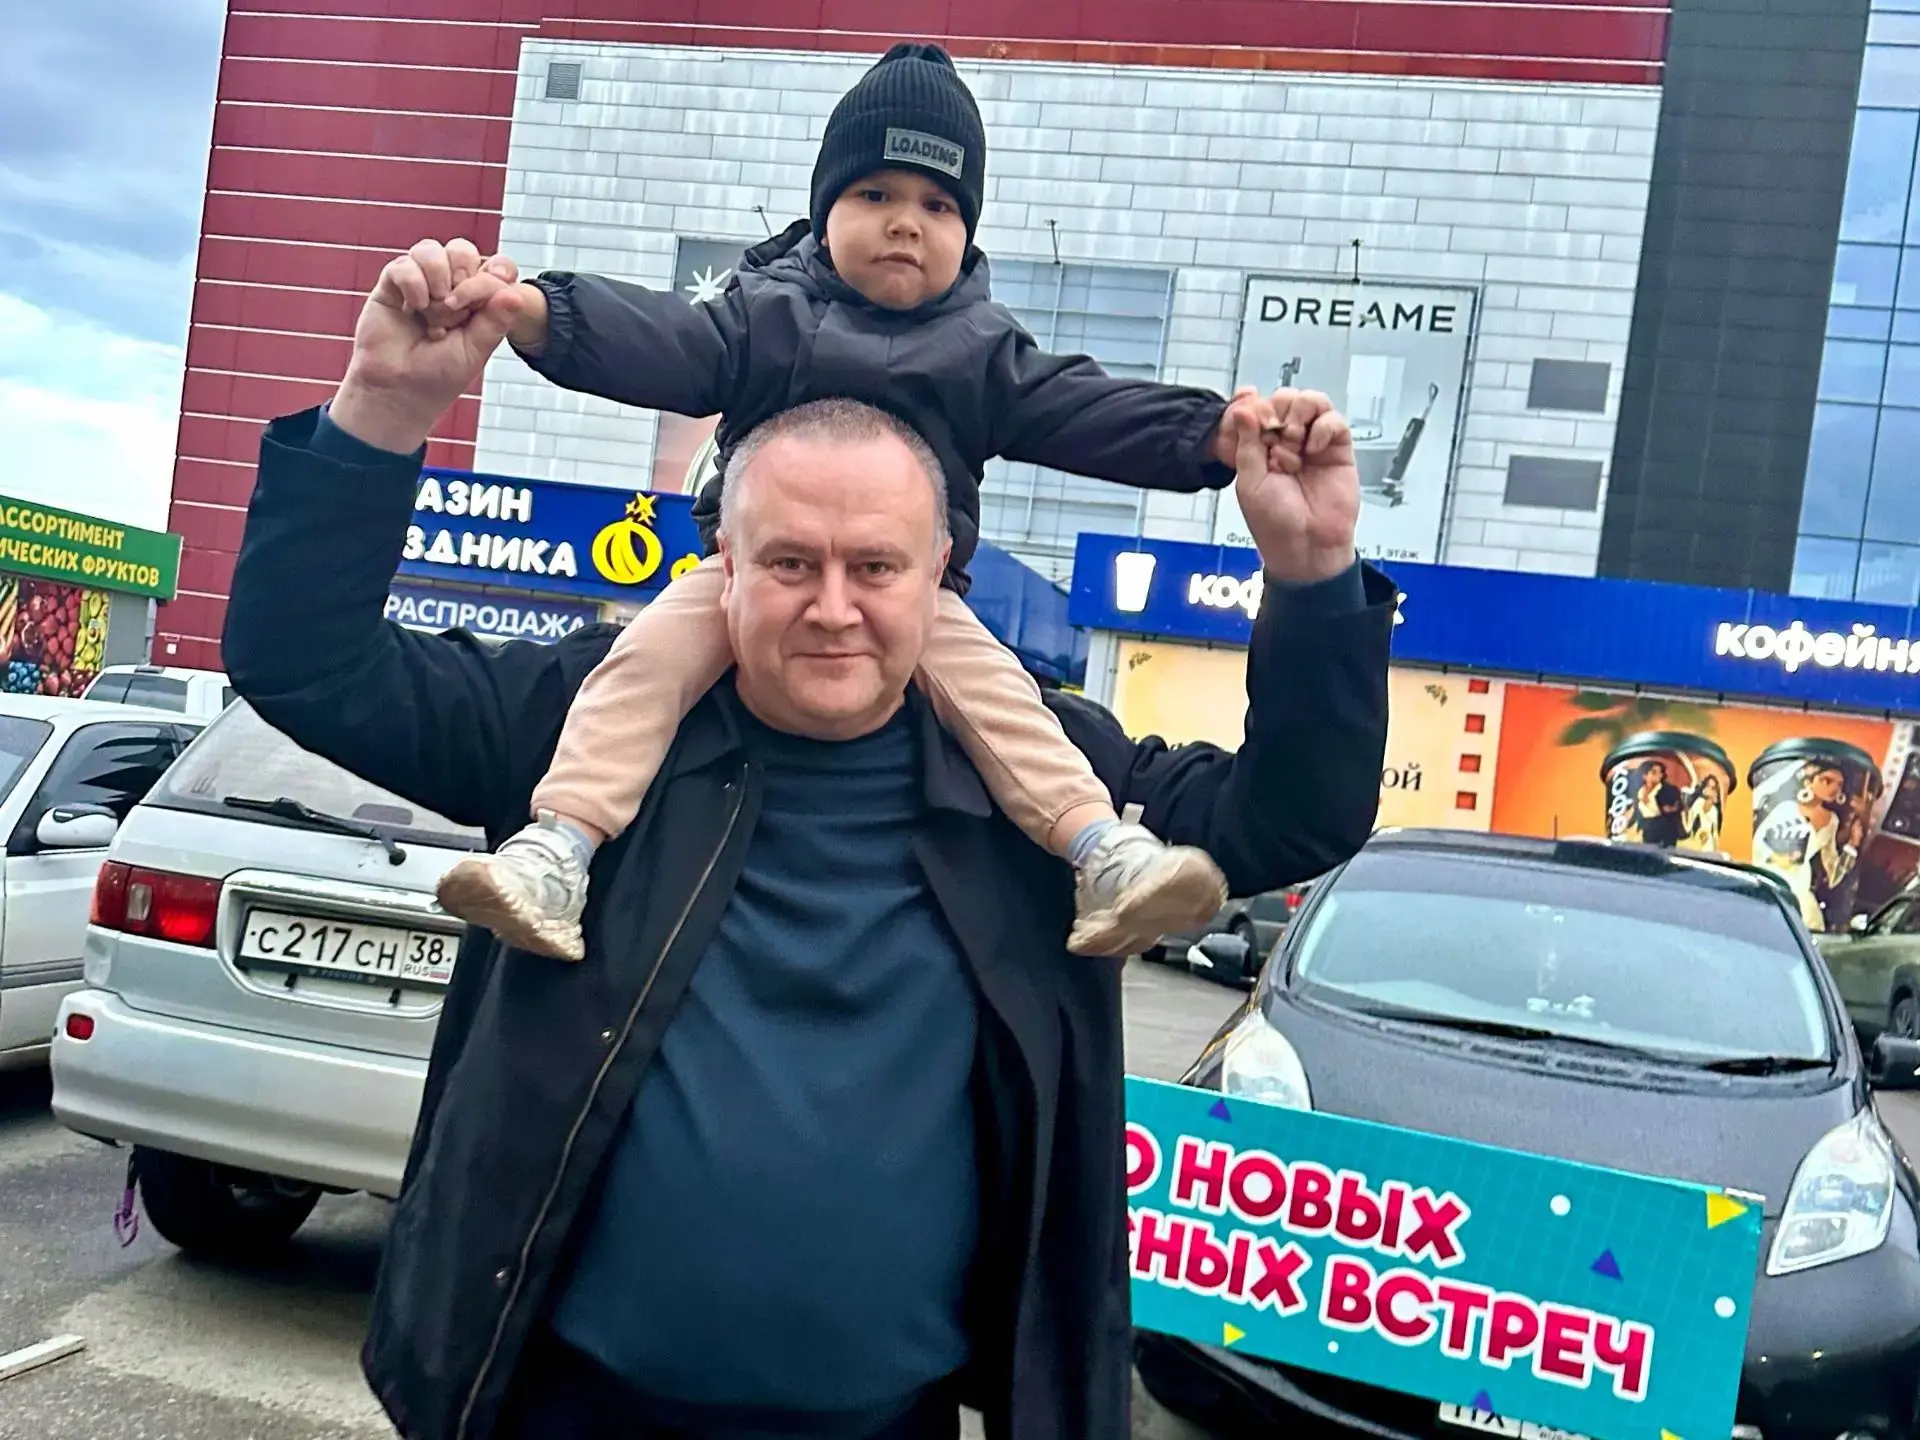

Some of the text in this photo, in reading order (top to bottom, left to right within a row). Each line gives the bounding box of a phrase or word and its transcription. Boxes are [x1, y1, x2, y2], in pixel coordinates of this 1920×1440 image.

[891, 136, 958, 167] LOADING
[1260, 295, 1456, 333] DREAME
[414, 477, 532, 523] АЗИН
[402, 525, 578, 578] ЗДНИКА
[1387, 548, 1420, 560] этаж
[82, 554, 160, 588] ФРУКТОВ
[410, 935, 444, 965] 38
[402, 962, 431, 977] RUS
[1169, 1135, 1471, 1267] НОВЫХ
[1128, 1207, 1655, 1402] НЫХ ВСТРЕЧ
